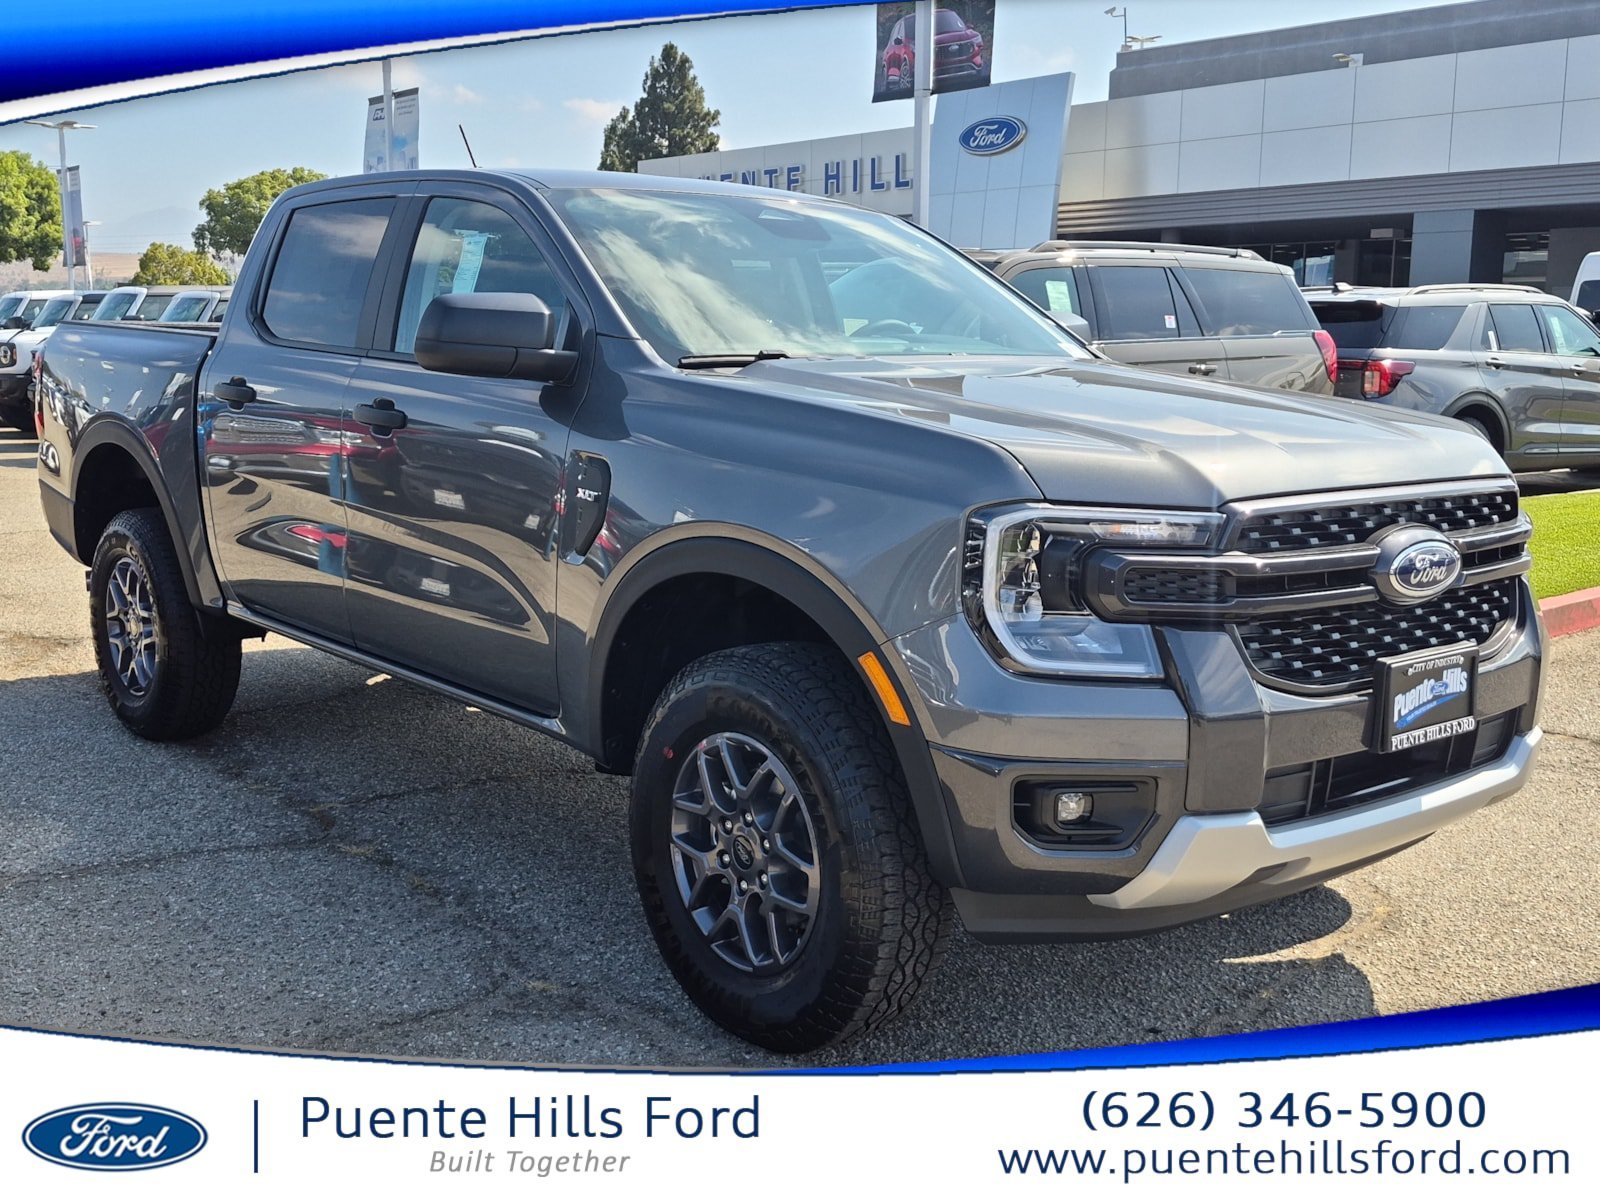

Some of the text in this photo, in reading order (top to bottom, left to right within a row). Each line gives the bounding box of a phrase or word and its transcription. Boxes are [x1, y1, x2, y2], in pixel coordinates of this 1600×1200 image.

[969, 124, 1006, 148] Ford
[824, 153, 911, 195] HILL
[1410, 554, 1448, 585] Ford
[1393, 679, 1435, 723] Puente
[1442, 667, 1468, 693] Hills
[1392, 717, 1476, 751] PUENTE HILLS FORD
